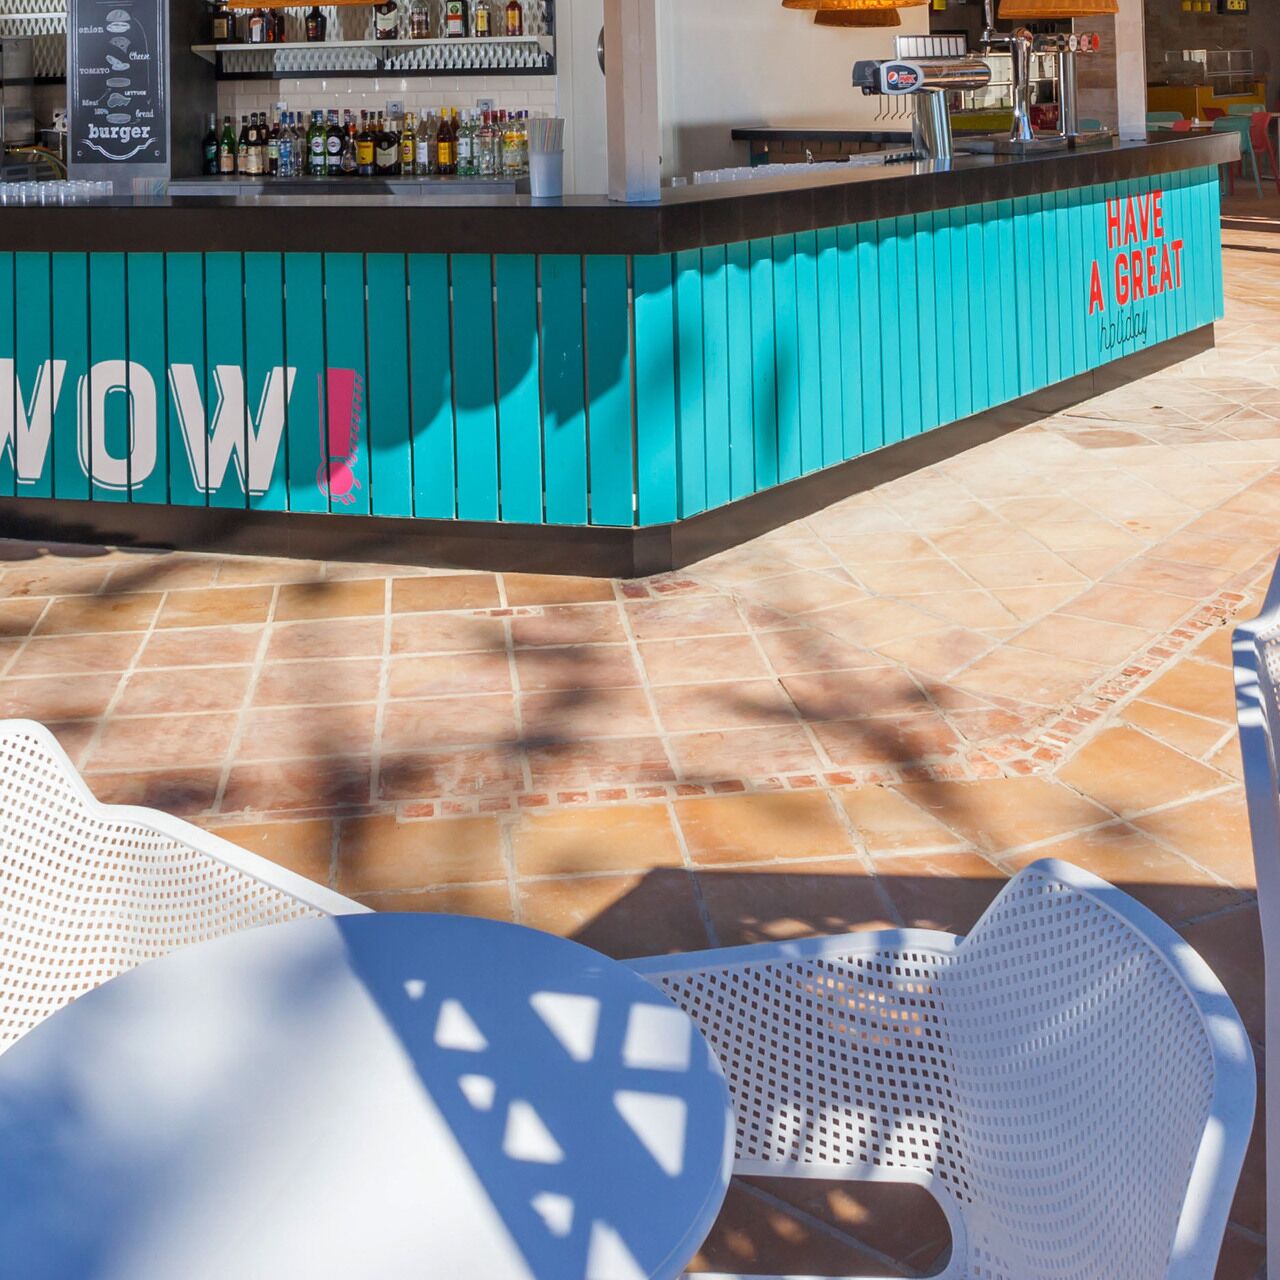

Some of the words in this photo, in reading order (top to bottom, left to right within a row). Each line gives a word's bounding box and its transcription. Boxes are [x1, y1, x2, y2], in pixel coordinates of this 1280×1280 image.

[78, 25, 104, 34] onion
[80, 67, 110, 75] TOMATO
[88, 123, 151, 143] burger
[1106, 189, 1165, 249] HAVE
[1088, 260, 1105, 316] A
[1114, 239, 1184, 306] GREAT
[1100, 308, 1148, 352] holiday
